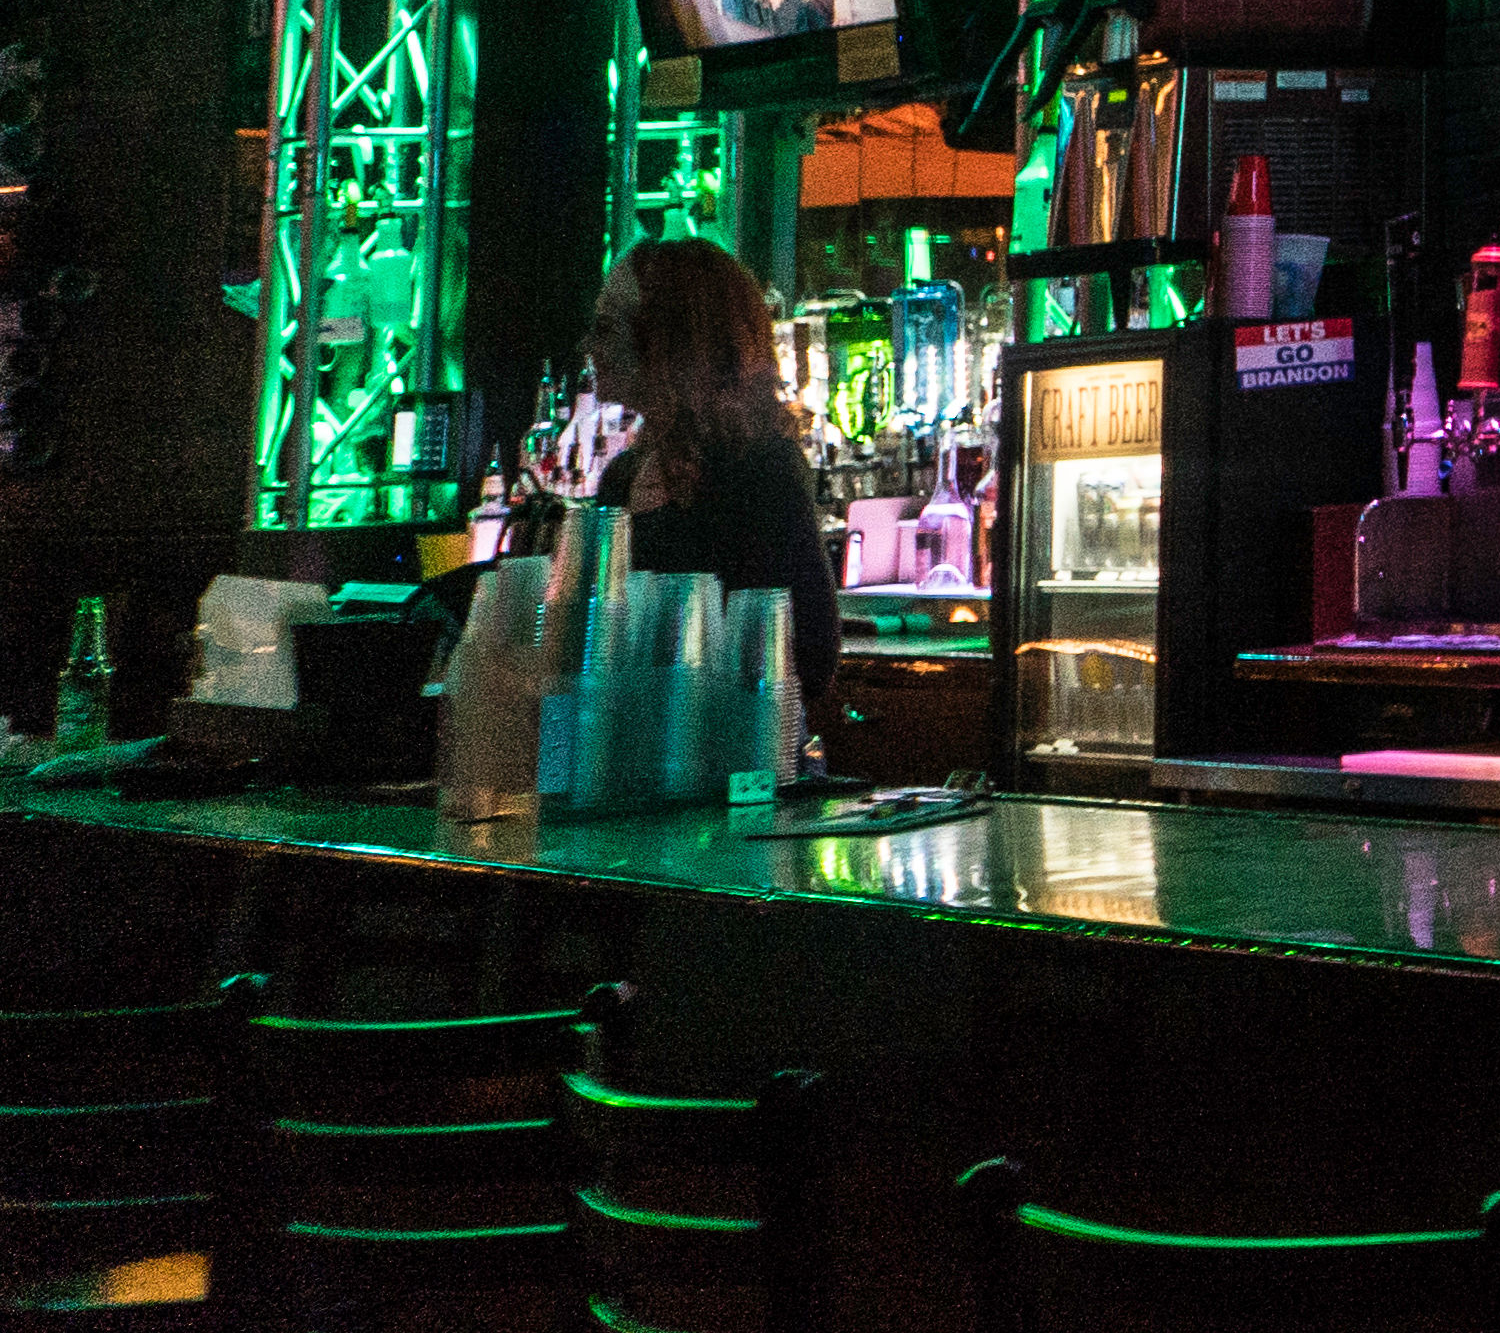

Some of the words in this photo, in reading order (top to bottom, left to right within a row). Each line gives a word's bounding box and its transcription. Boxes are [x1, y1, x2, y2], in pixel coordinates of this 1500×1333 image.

[1263, 321, 1326, 344] LET'S
[1276, 344, 1314, 365] GO
[1241, 363, 1349, 390] BRANDON
[1040, 385, 1101, 450] CRAFT
